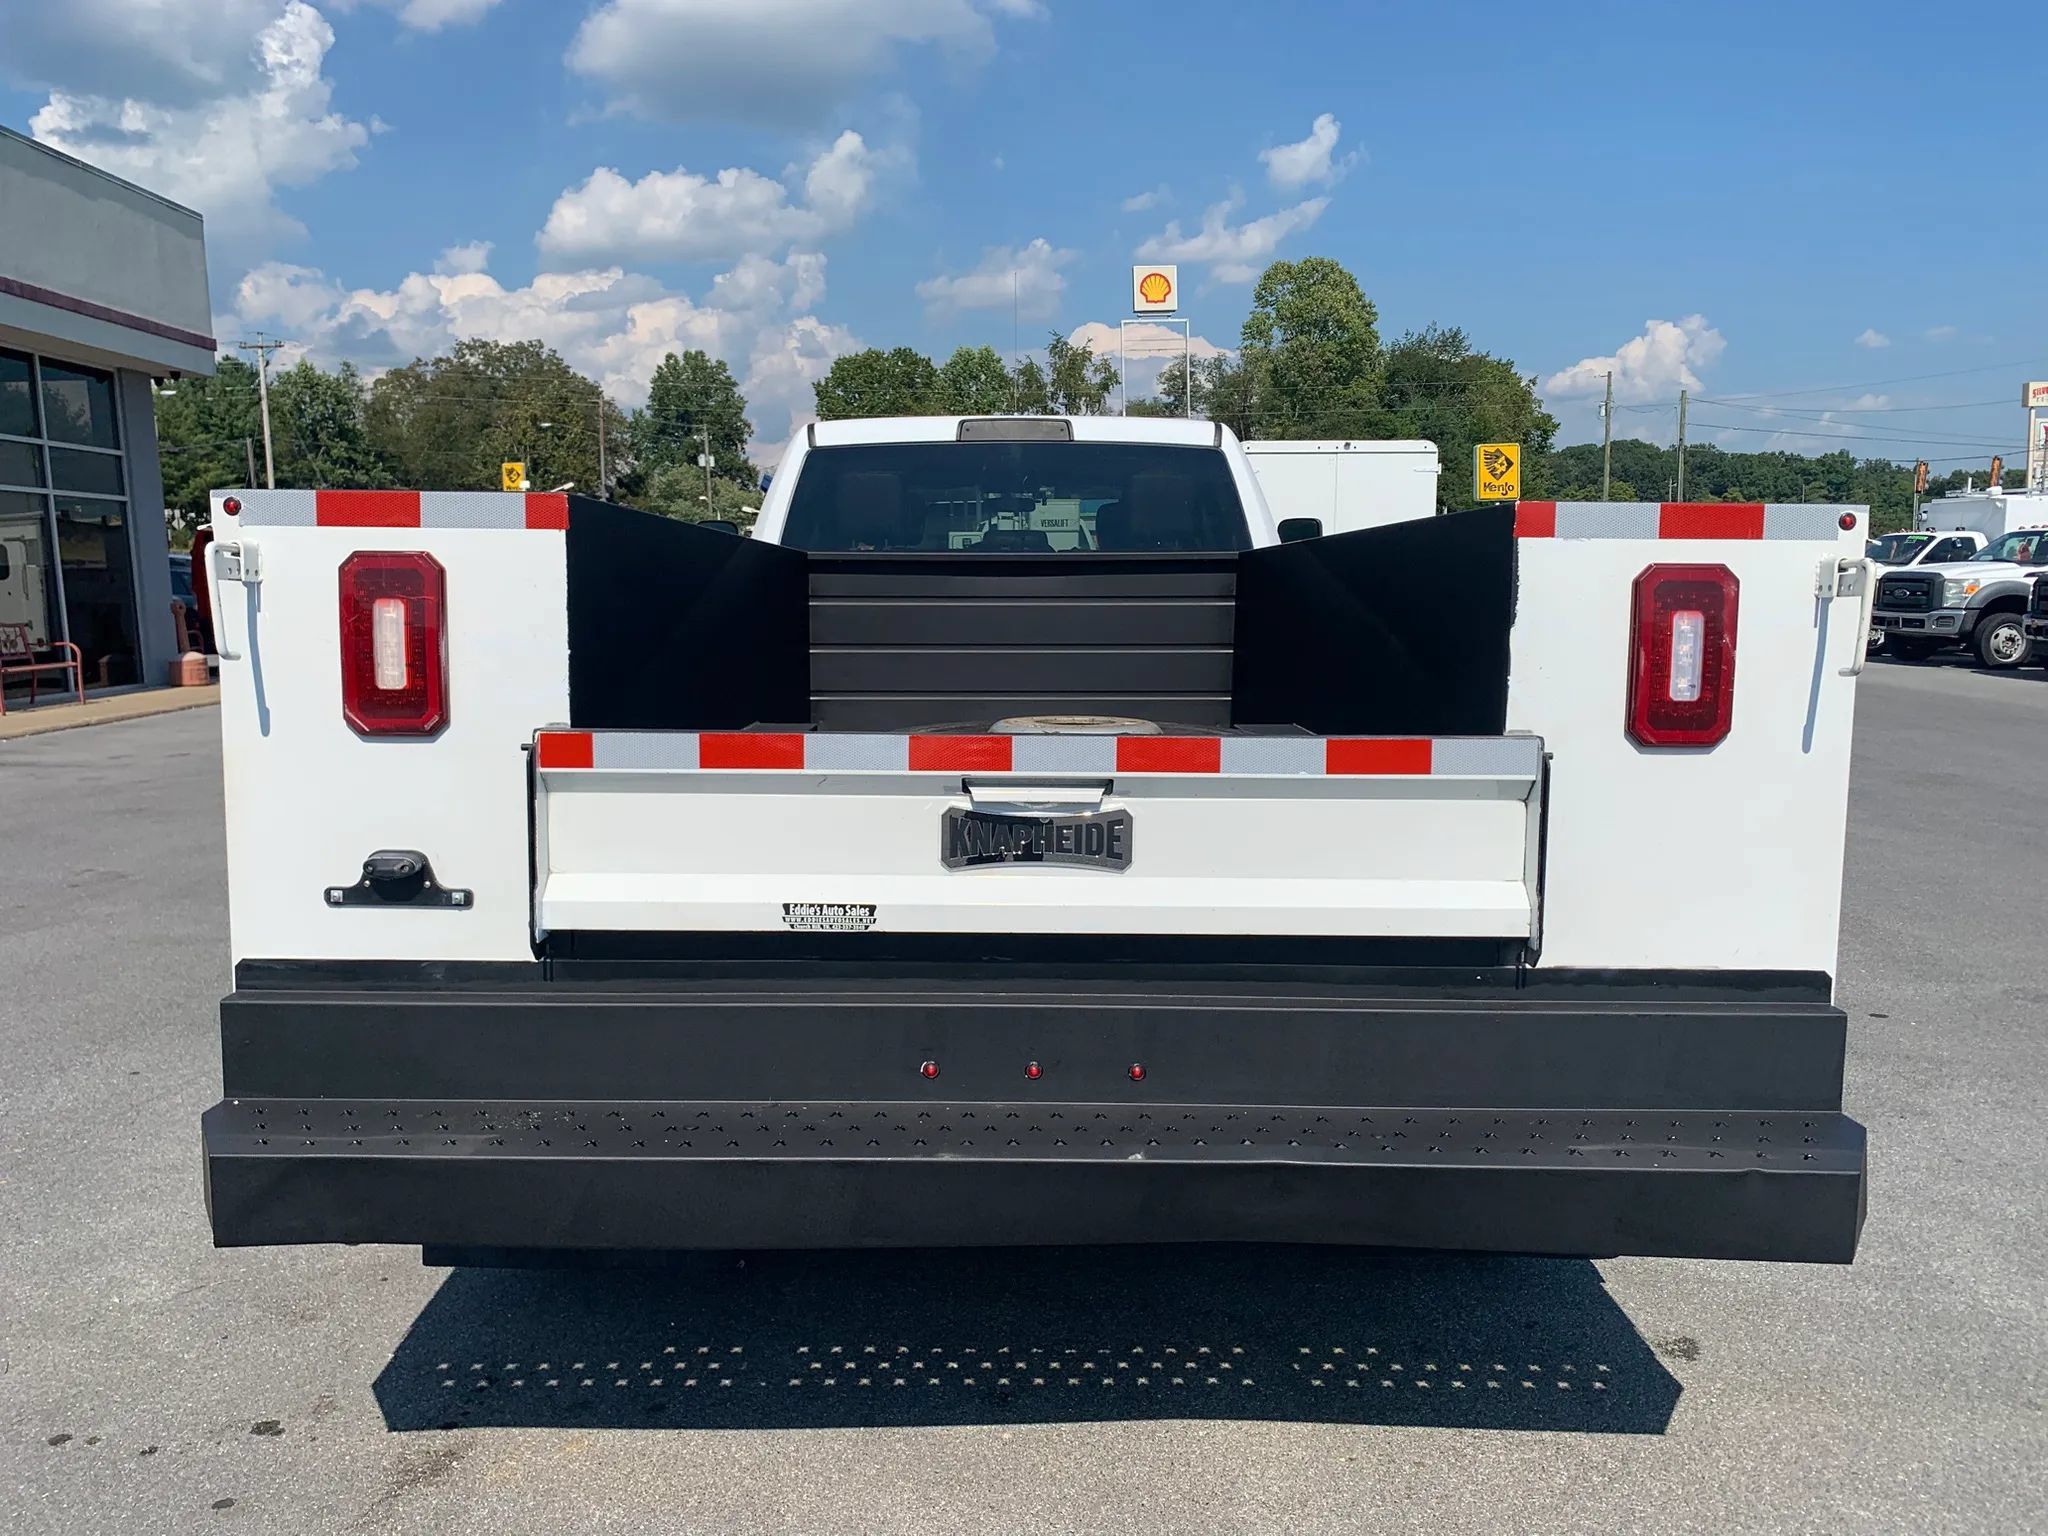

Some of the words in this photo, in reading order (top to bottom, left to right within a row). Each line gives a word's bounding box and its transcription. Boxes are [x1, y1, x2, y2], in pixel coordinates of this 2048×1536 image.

[1483, 482, 1515, 496] Kenjo
[1040, 519, 1069, 528] VERSALIFT
[949, 814, 1125, 861] KNAPHEIDE
[789, 903, 821, 916] Eddie's
[822, 904, 844, 916] Auto
[845, 904, 870, 917] Sales
